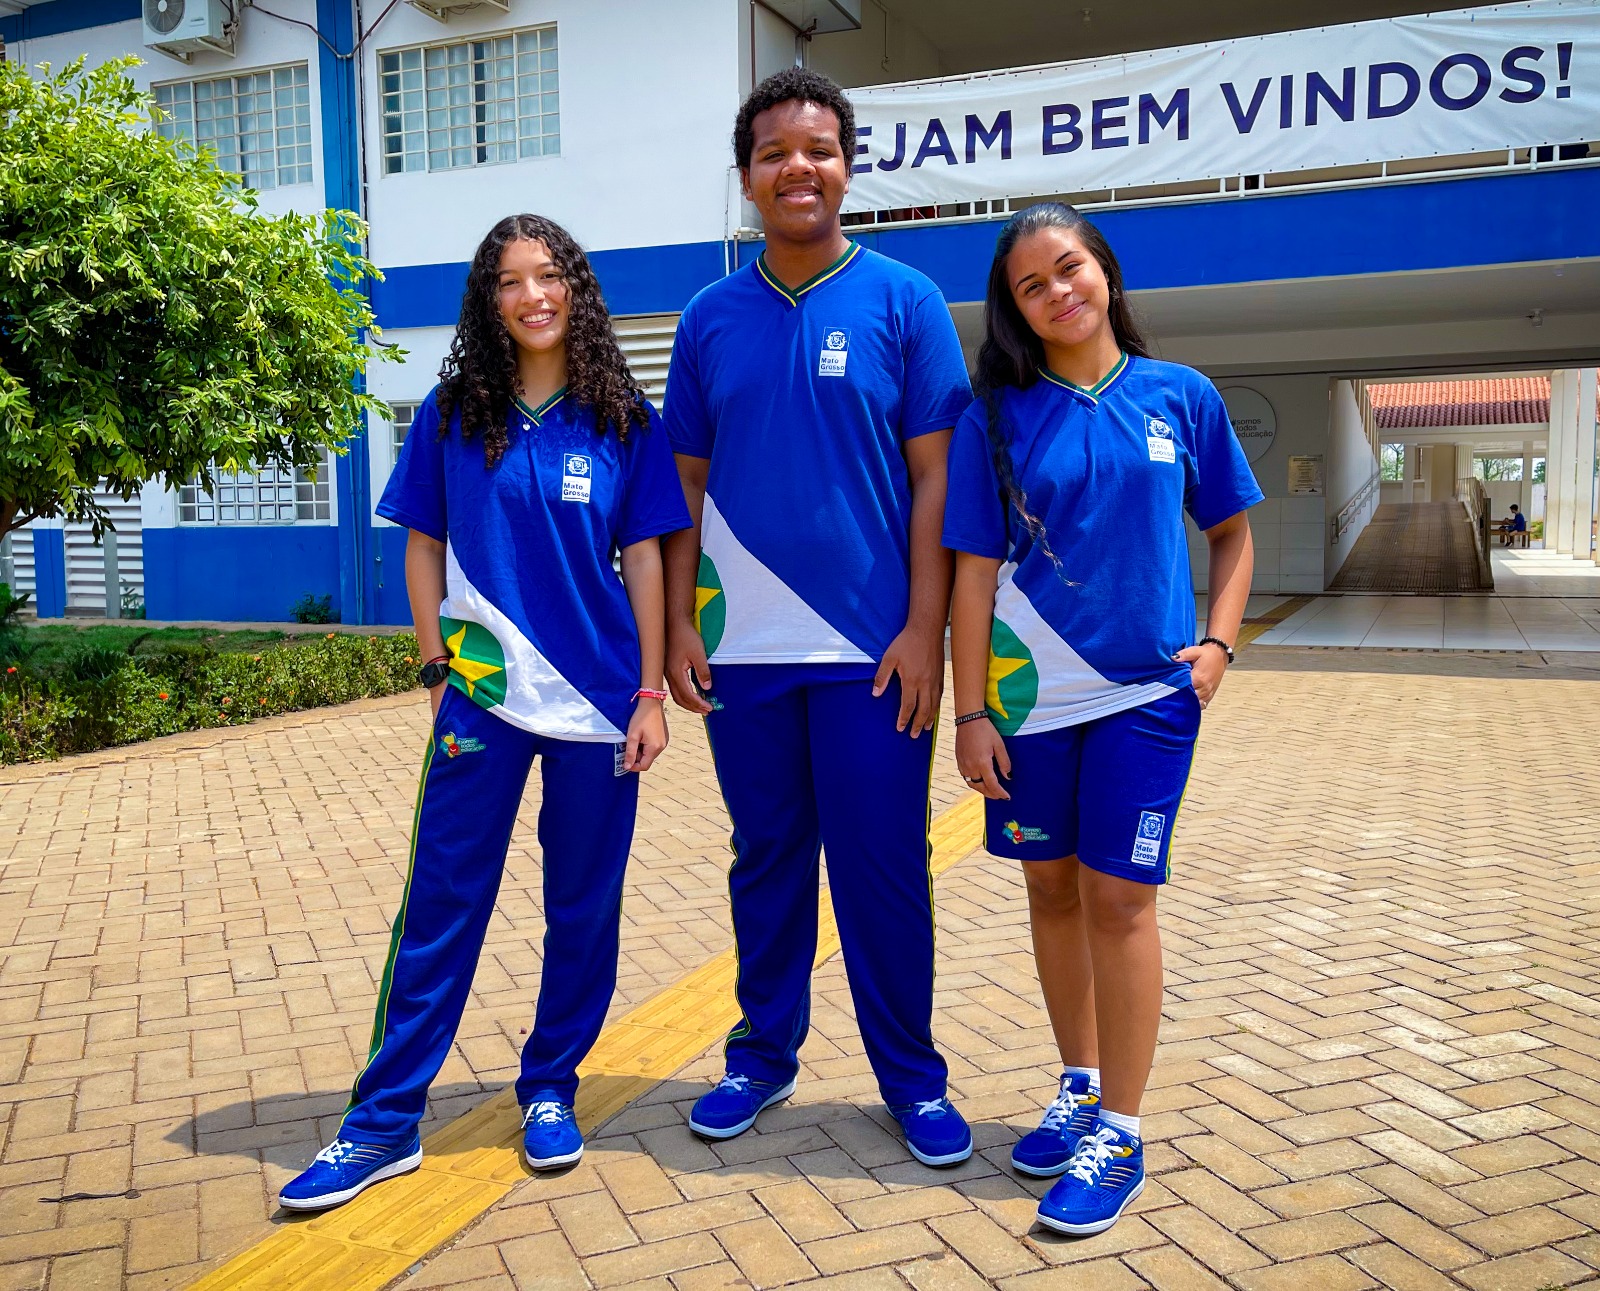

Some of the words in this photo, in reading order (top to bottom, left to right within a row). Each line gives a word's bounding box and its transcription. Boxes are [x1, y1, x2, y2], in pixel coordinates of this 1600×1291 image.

[1042, 88, 1190, 156] BEM
[1220, 42, 1573, 134] VINDOS!
[1150, 449, 1175, 457] Grosso
[563, 482, 584, 490] Mato
[563, 489, 590, 498] Grosso
[1135, 843, 1153, 853] Mato
[1133, 850, 1157, 861] Grosso
